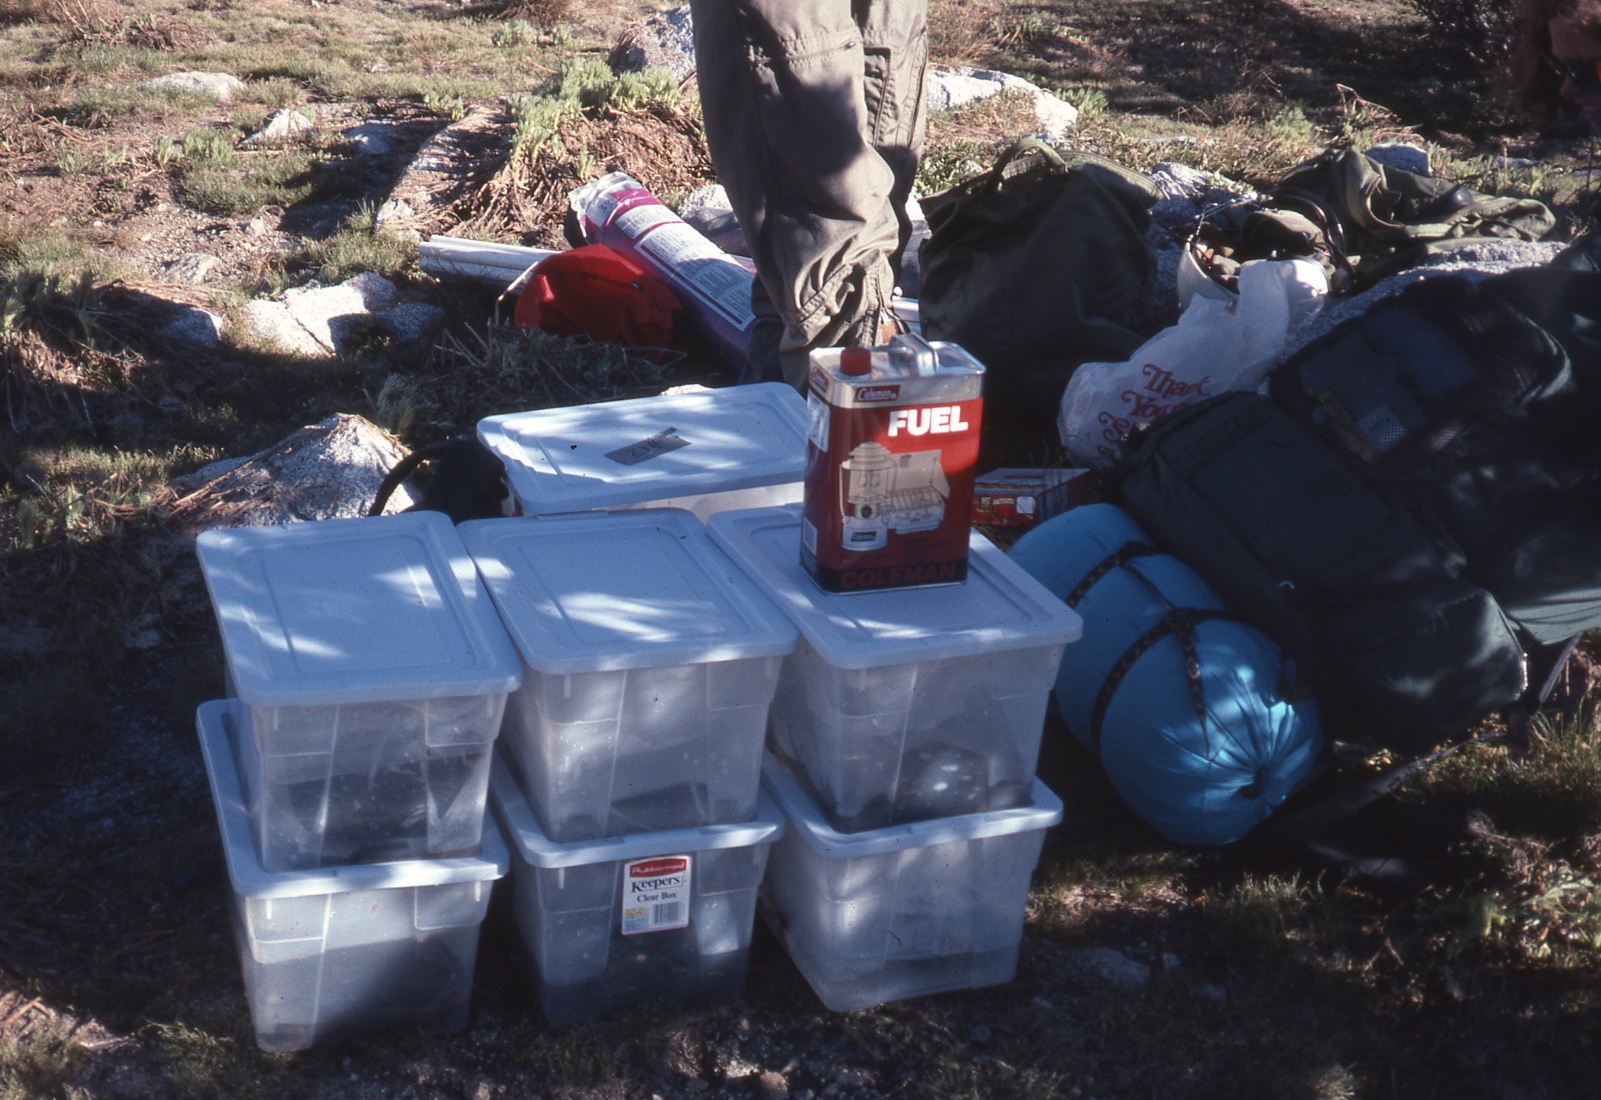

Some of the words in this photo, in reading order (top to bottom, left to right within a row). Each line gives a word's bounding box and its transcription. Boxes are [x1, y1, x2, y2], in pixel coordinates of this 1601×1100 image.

[888, 406, 968, 437] FUEL
[841, 561, 956, 588] COLEMAN
[632, 862, 685, 874] Rubbermaid
[631, 876, 680, 893] Keepers
[637, 894, 659, 903] Clear
[661, 892, 677, 900] Box
